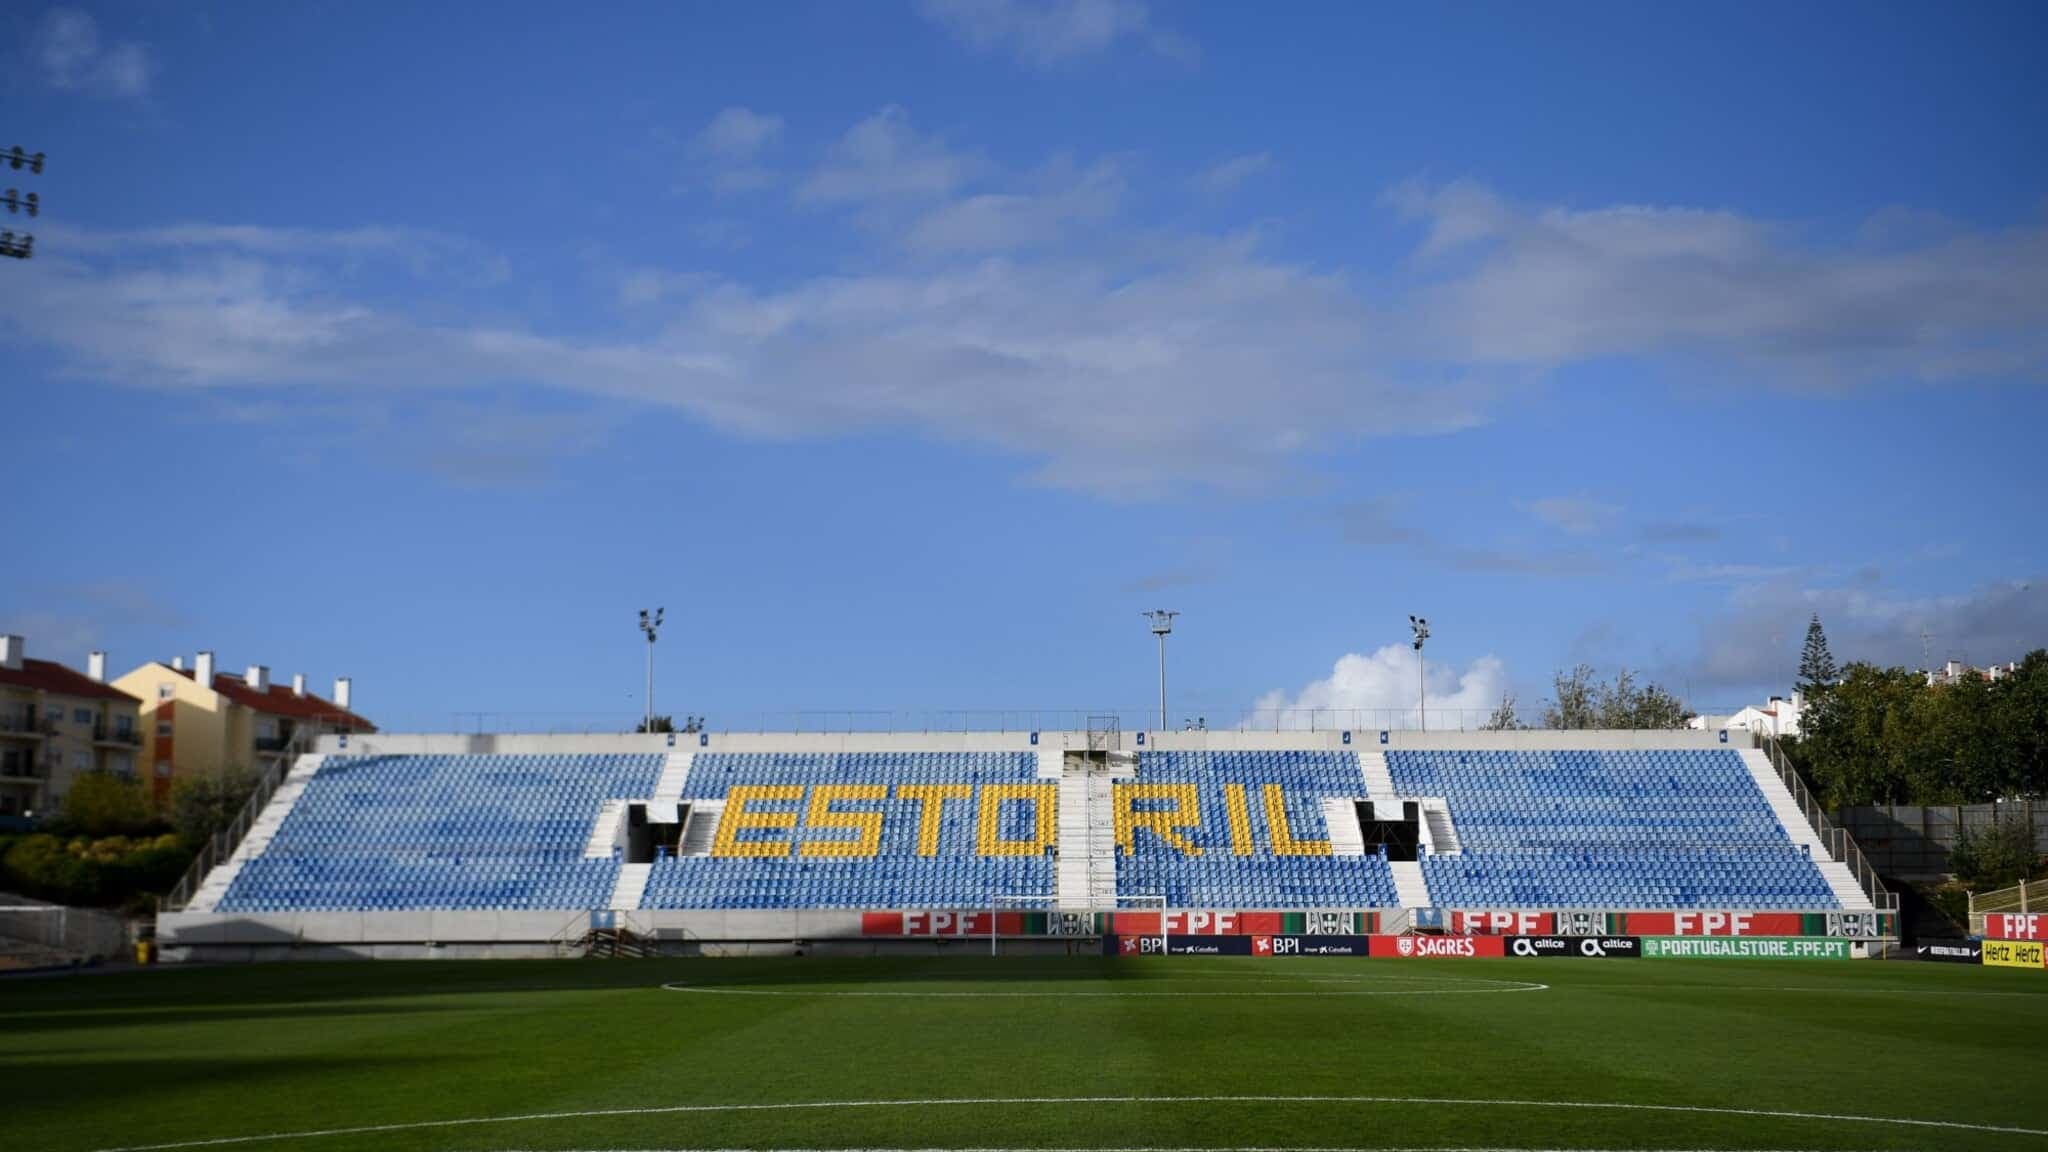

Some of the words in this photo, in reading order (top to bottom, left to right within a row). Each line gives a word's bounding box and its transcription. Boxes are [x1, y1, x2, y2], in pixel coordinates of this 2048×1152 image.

[902, 912, 979, 935] FPF
[1160, 912, 1240, 935] FPF
[1463, 912, 1540, 935] FPF
[1674, 912, 1754, 936] FPF
[2003, 914, 2038, 939] FPF
[1273, 938, 1299, 953] BPI
[1416, 937, 1475, 956] SAGRES
[1535, 938, 1565, 949] altice
[1602, 938, 1633, 949] altice
[1661, 939, 1843, 957] PORTUGALSTORE.FPF.PT
[1985, 944, 2009, 961] Hertz
[2015, 945, 2040, 963] Hertz
